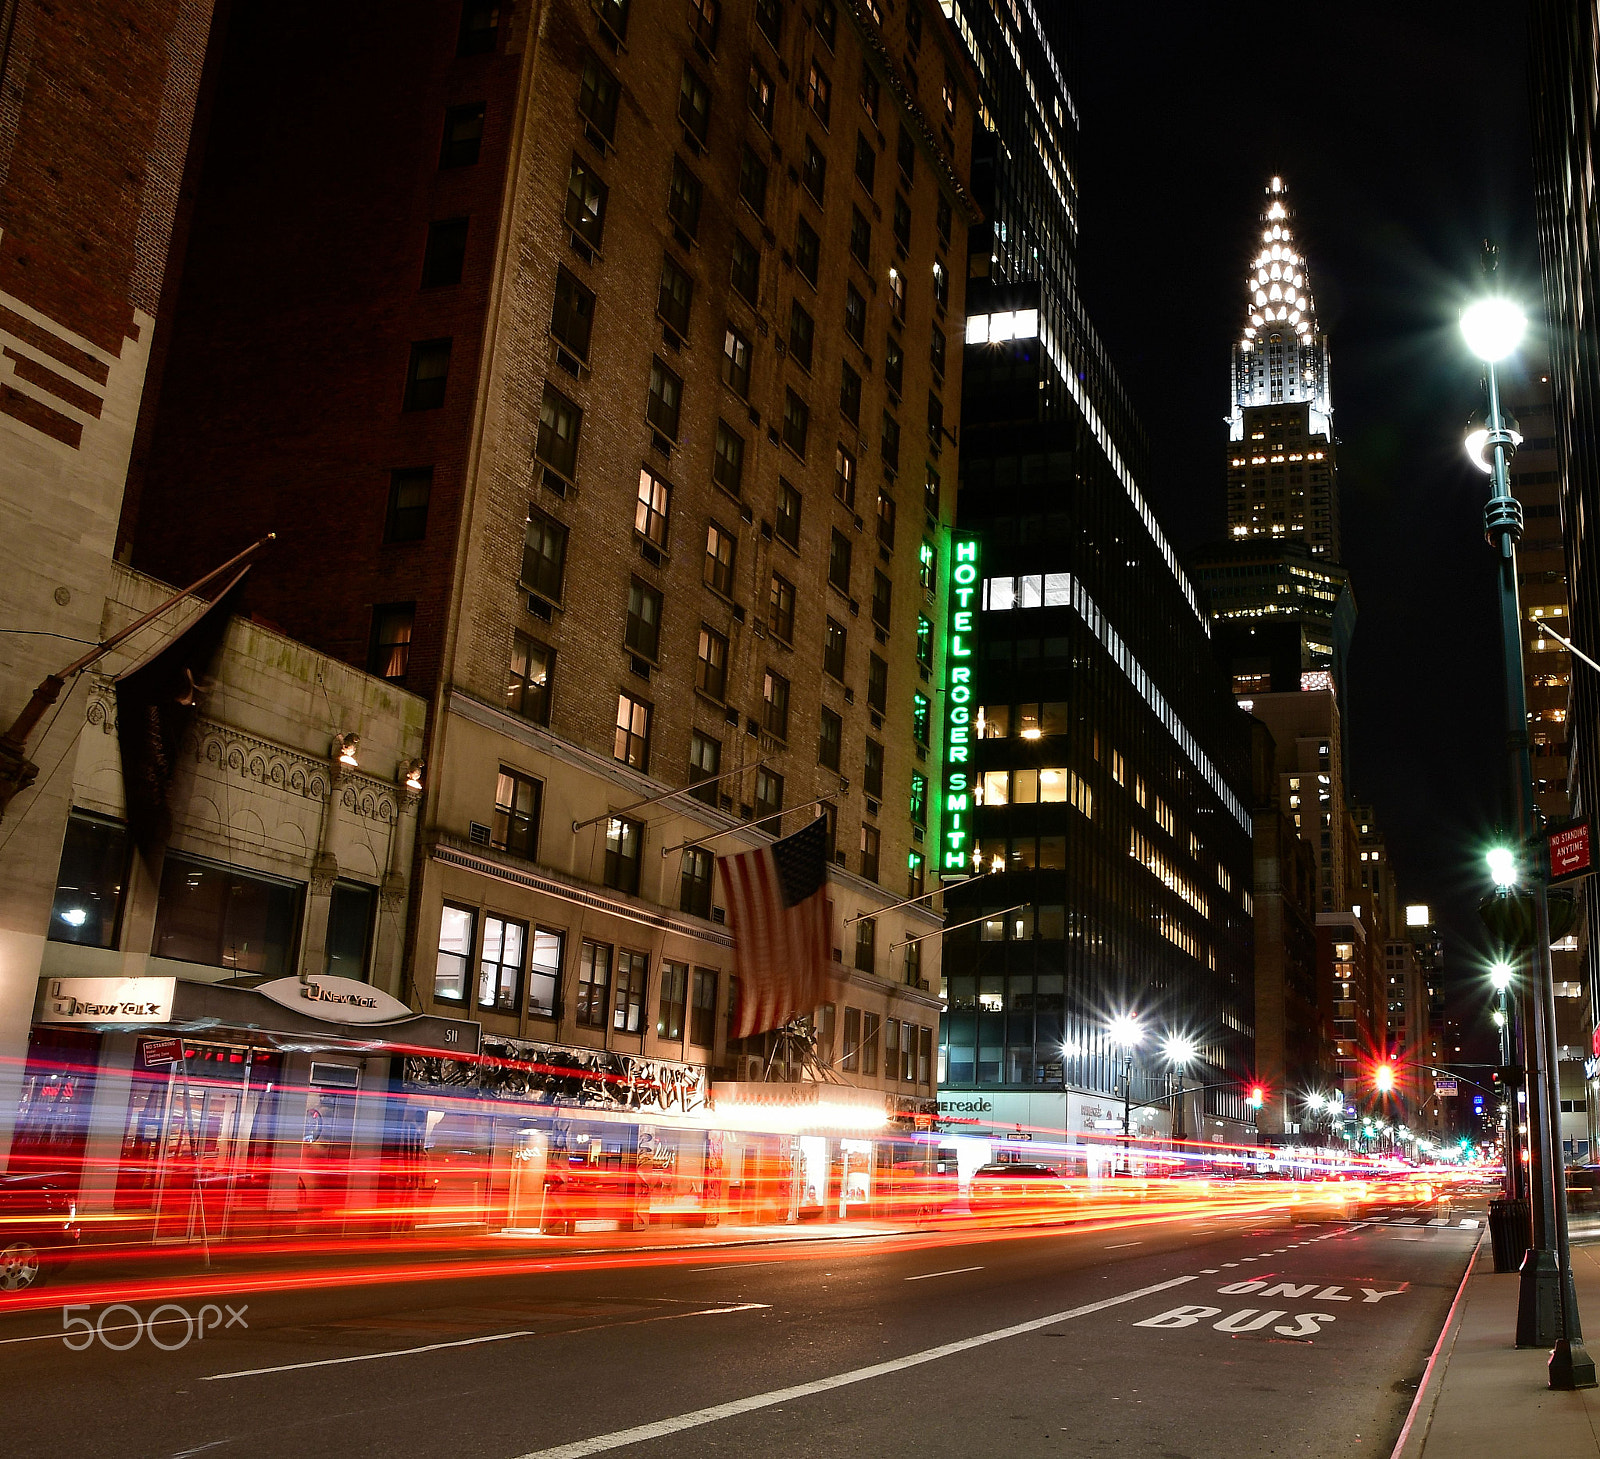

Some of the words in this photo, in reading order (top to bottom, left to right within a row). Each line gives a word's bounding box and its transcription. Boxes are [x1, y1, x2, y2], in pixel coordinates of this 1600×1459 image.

[953, 541, 976, 656] HOTEL
[950, 667, 971, 762] ROGER
[946, 773, 967, 868] SMITH
[1552, 836, 1560, 846] NO
[1562, 827, 1587, 843] STANDING
[1557, 840, 1583, 857] ANYTIME
[76, 1002, 118, 1016] New
[119, 1002, 161, 1016] York
[321, 990, 350, 1004] New
[350, 995, 378, 1010] York
[153, 1041, 176, 1049] STANDING
[1217, 1281, 1404, 1303] ONLY
[1132, 1305, 1336, 1336] BUS
